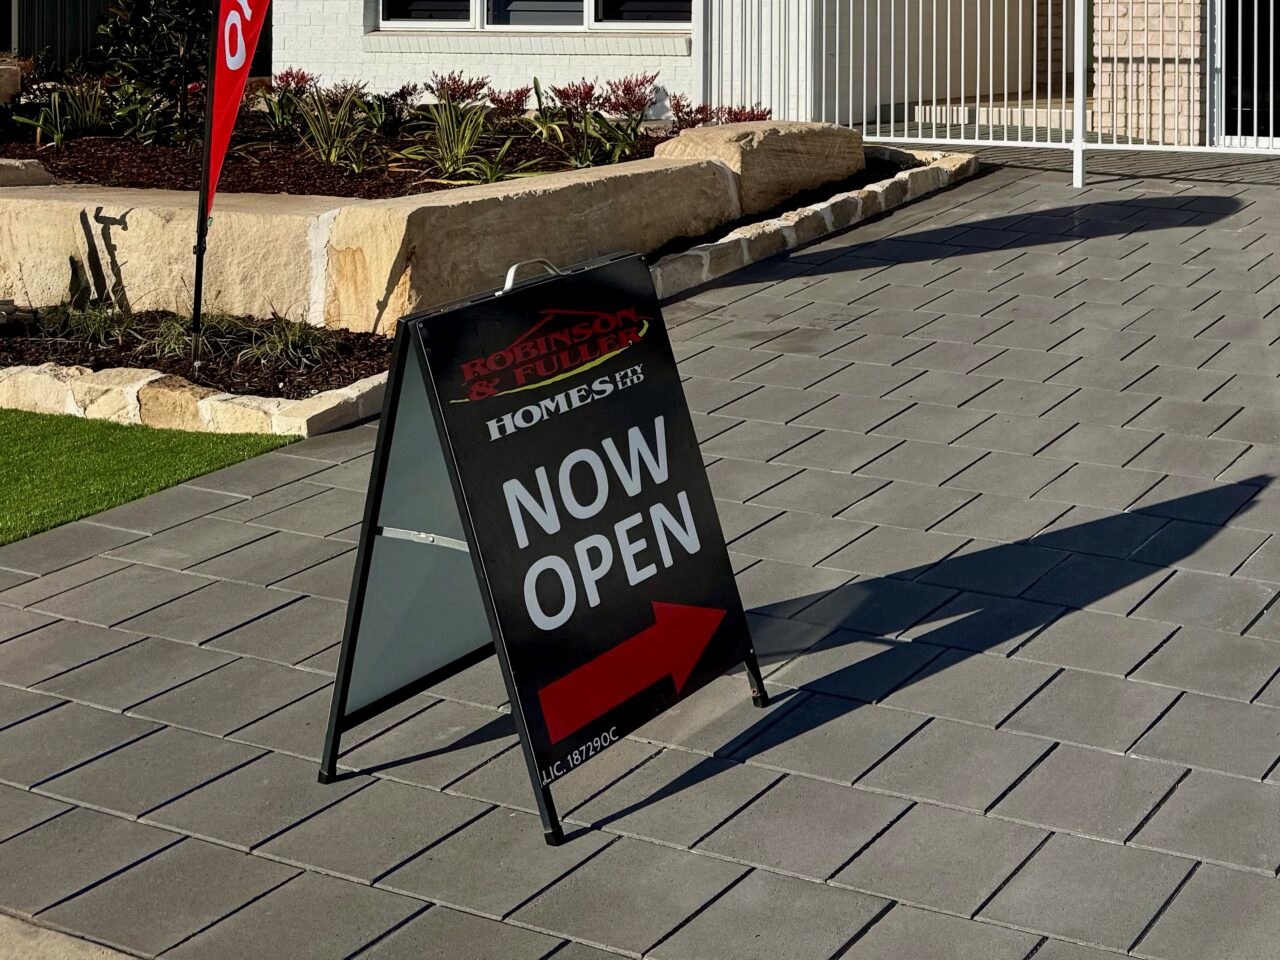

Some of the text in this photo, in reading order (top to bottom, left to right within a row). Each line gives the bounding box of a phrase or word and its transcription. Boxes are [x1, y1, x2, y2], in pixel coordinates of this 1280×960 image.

[461, 307, 638, 381] ROBINSON
[468, 326, 643, 401] & FULLER
[614, 363, 643, 381] PTY
[486, 375, 615, 441] HOMES
[617, 373, 645, 390] LTD
[503, 415, 669, 549] NOW
[523, 490, 701, 631] OPEN
[542, 761, 567, 786] LIC.
